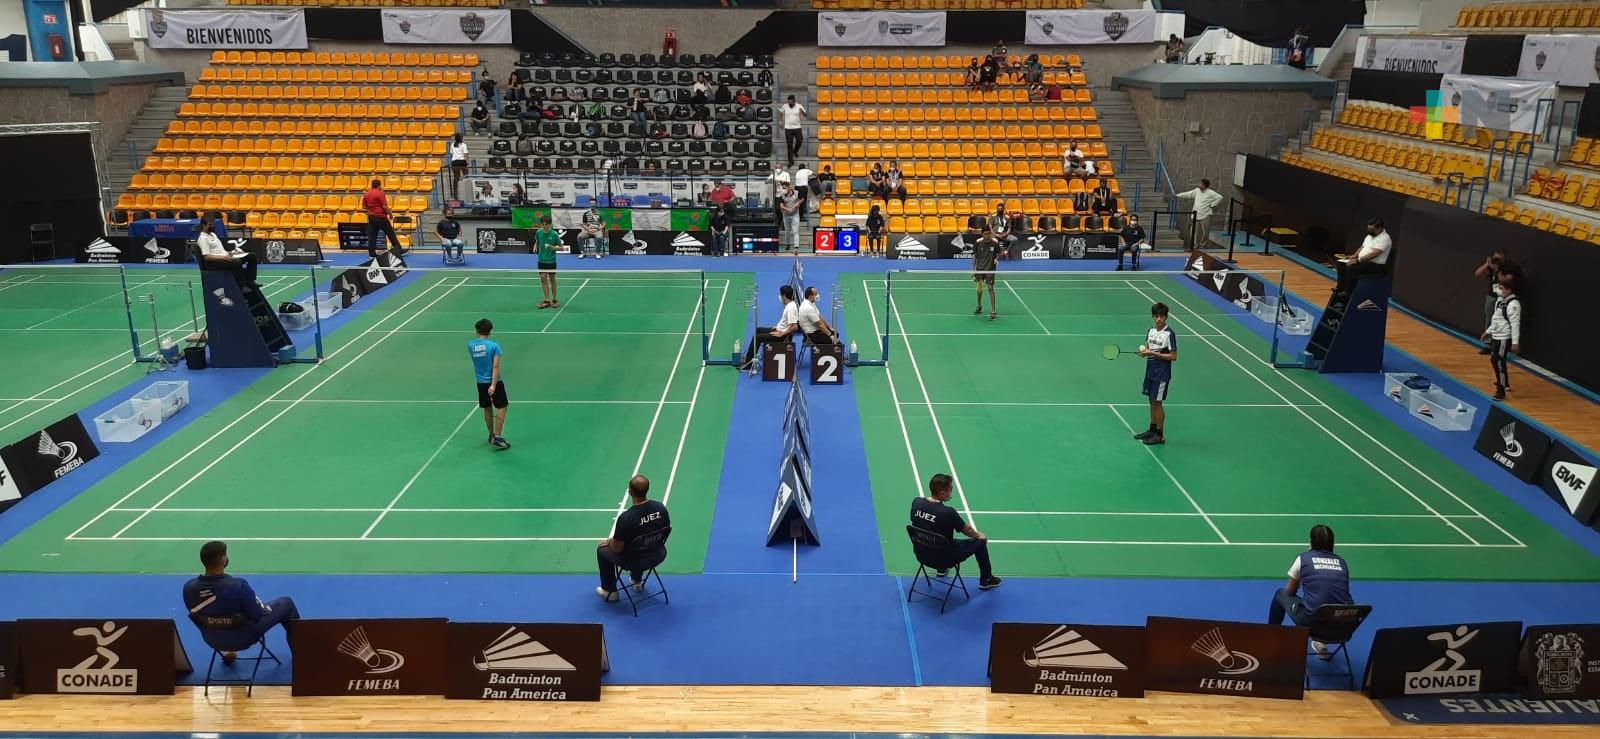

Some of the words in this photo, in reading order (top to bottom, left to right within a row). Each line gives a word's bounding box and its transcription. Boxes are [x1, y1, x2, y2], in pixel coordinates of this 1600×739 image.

[187, 28, 273, 44] BIENVENIDOS
[820, 235, 829, 247] 2
[843, 235, 852, 247] 3
[773, 353, 786, 380] 1
[817, 355, 838, 382] 2
[54, 456, 85, 478] FEMEBA
[1555, 465, 1586, 491] BWF
[639, 511, 661, 526] JUEZ
[914, 509, 936, 523] JUEZ
[61, 674, 134, 687] CONADE
[488, 673, 562, 685] Badminton
[1039, 670, 1113, 683] Badminton
[1409, 674, 1477, 689] CONADE
[348, 679, 400, 690] FEMEBA
[1033, 684, 1058, 694] Pan
[1061, 685, 1119, 697] America
[1200, 678, 1253, 692] FEMEBA
[482, 688, 507, 699] Pan
[510, 688, 567, 700] America
[1439, 699, 1600, 713] ALIENTES
